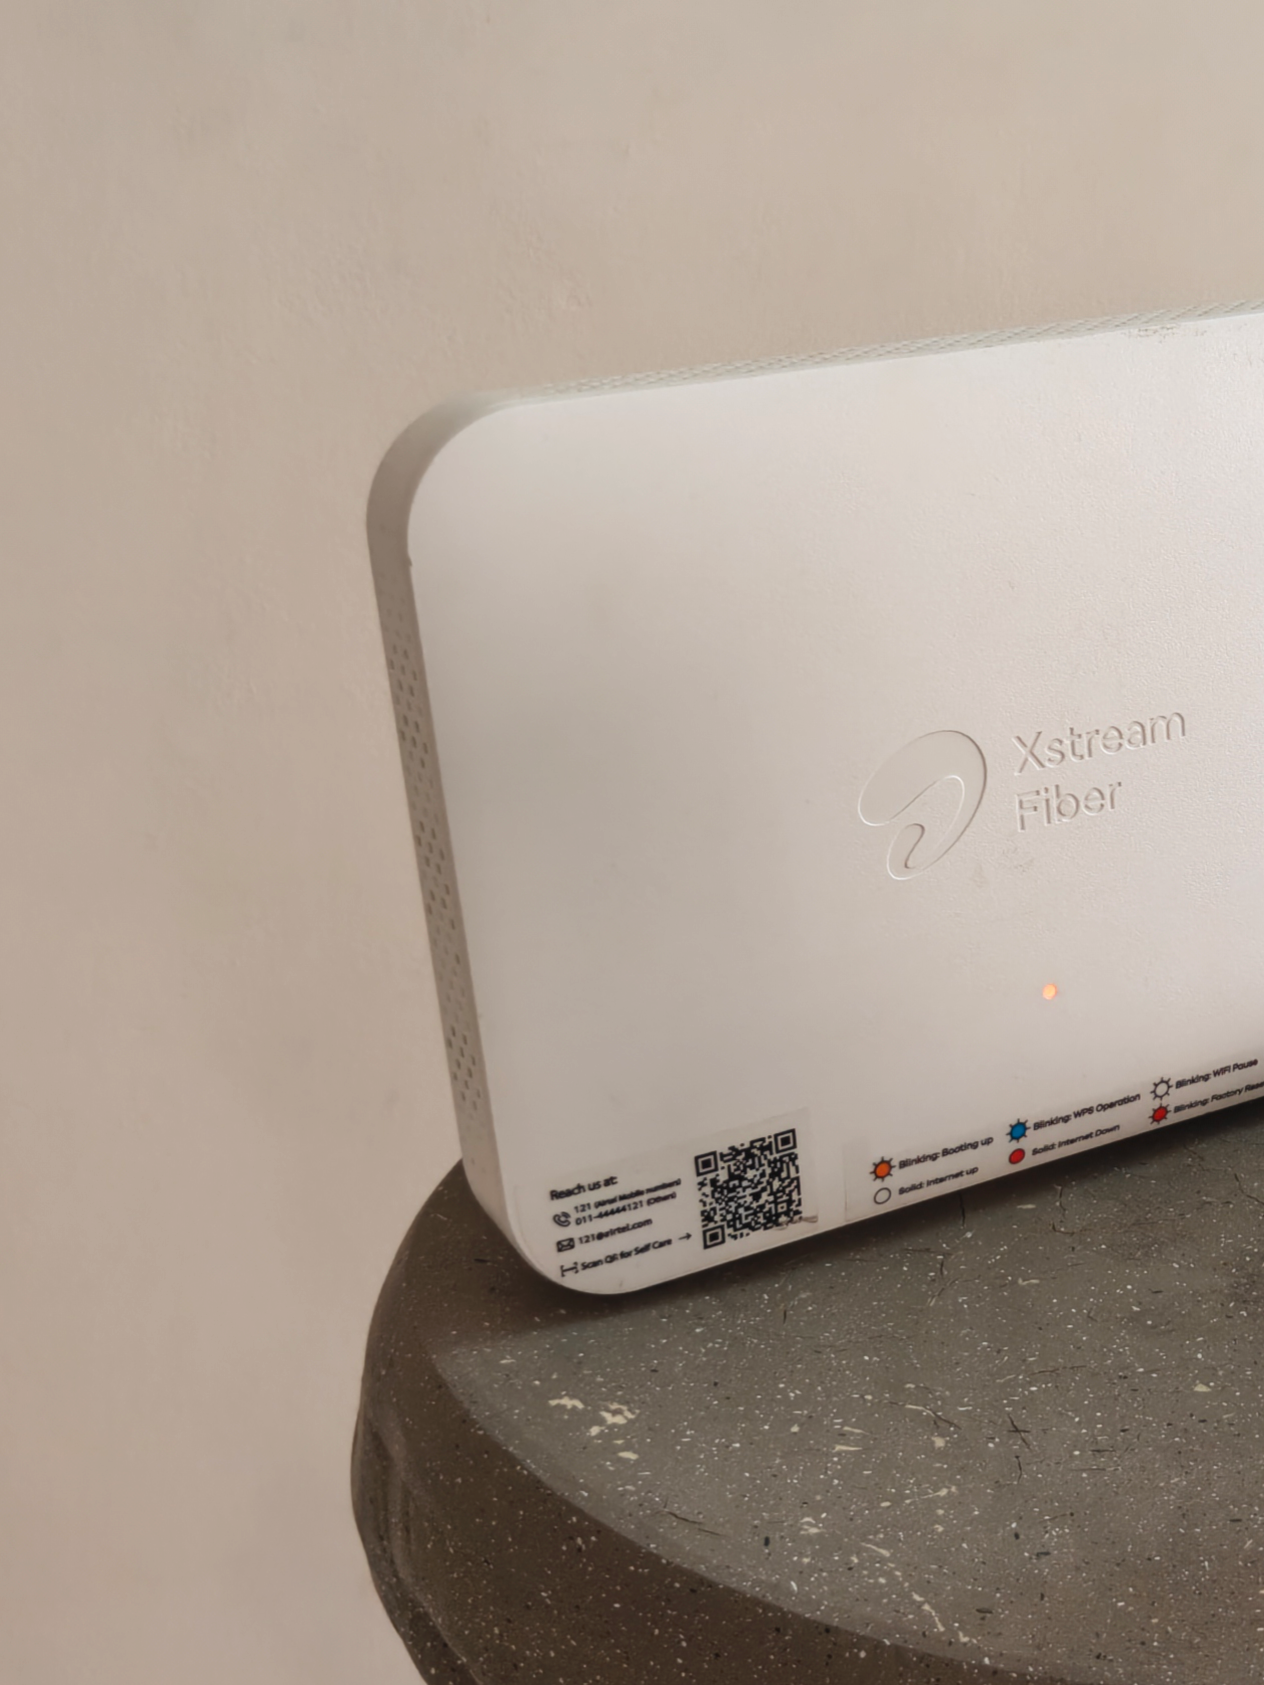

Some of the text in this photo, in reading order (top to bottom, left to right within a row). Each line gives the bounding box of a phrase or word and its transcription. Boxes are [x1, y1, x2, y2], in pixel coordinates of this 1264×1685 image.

[1012, 712, 1186, 775] Xstream
[1016, 781, 1122, 832] Fiber
[1175, 1073, 1211, 1089] Blinking:
[1233, 1059, 1258, 1072] Pause
[1033, 1094, 1141, 1131] Blinking: WPS Operation
[1174, 1098, 1209, 1113] Blinking:
[1211, 1088, 1243, 1102] Factory
[899, 1137, 994, 1169] Blinking: Booting up
[1032, 1125, 1120, 1156] Solid: Internet Down
[550, 1183, 586, 1201] Reach
[588, 1181, 602, 1191] us
[898, 1167, 979, 1195] Solid: Internet up
[574, 1203, 591, 1213] 121
[619, 1189, 645, 1201] Mobile
[575, 1191, 677, 1226] 011-44444121 (Others)
[578, 1219, 653, 1244] 121@airtel.com
[581, 1239, 673, 1271] Scan QR for Self Care
